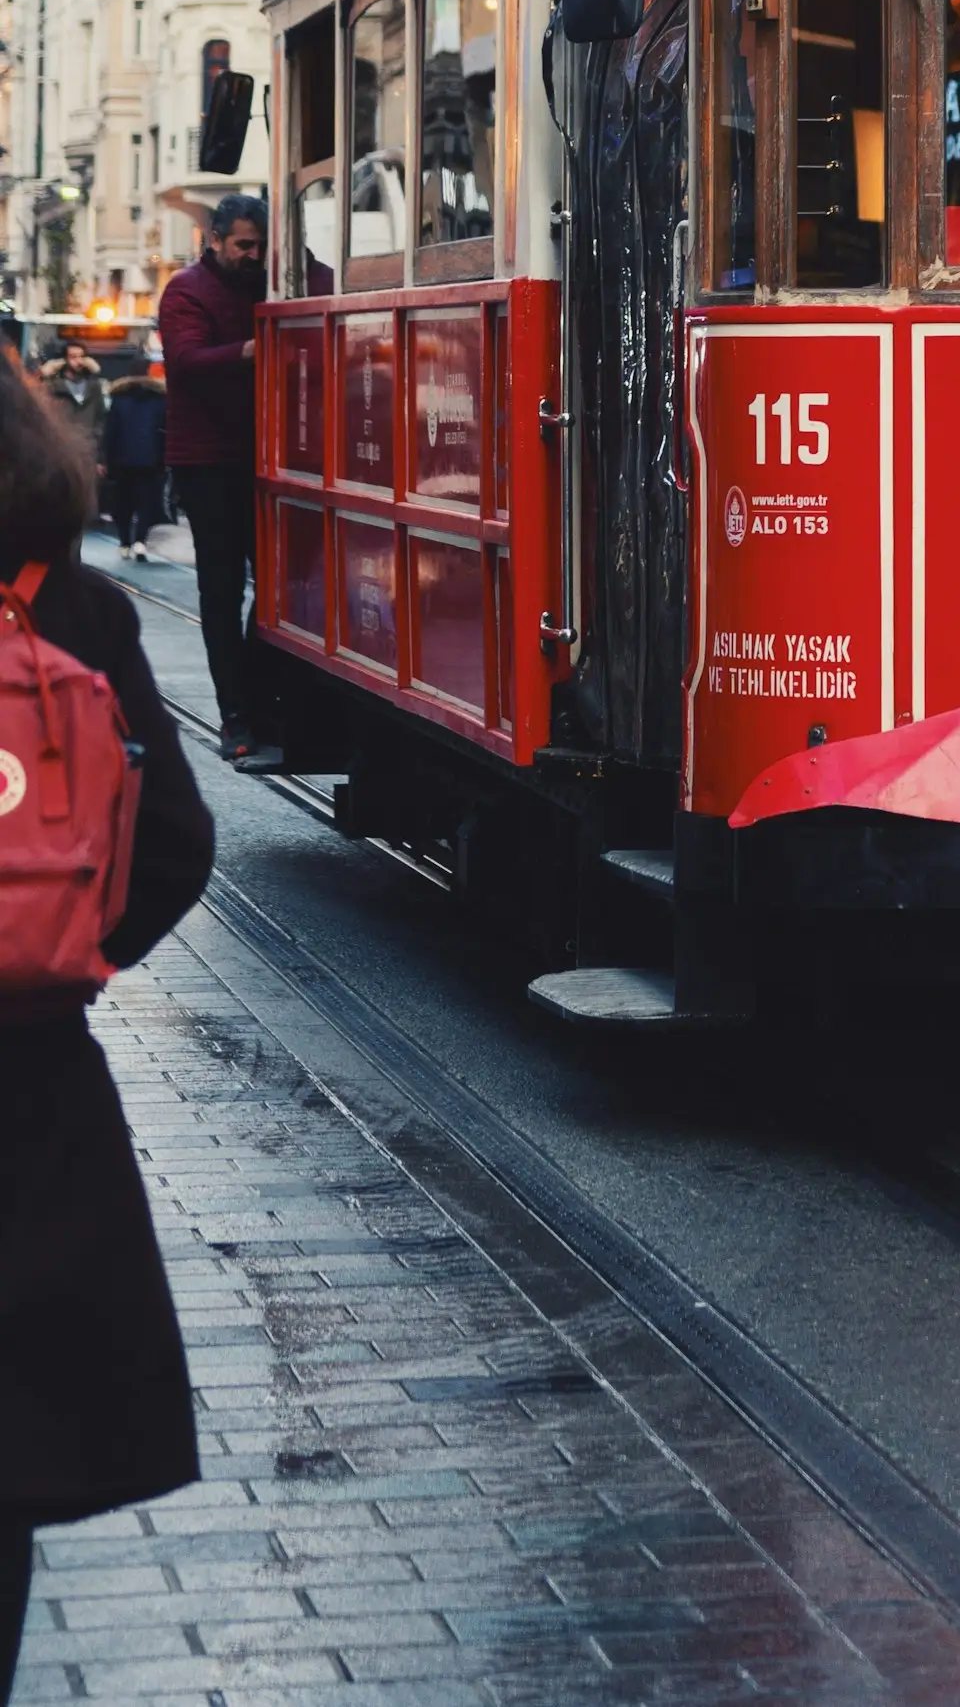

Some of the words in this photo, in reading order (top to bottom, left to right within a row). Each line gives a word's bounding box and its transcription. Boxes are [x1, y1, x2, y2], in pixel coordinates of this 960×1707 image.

[748, 392, 830, 465] 115
[751, 493, 828, 509] www.iett.gov.tr
[751, 515, 787, 535] ALO
[792, 515, 829, 535] 153
[713, 631, 776, 662] ASILMAK
[784, 634, 852, 664] YASAK
[708, 665, 723, 693] VE
[728, 665, 857, 700] TEHLİKELİDİR
